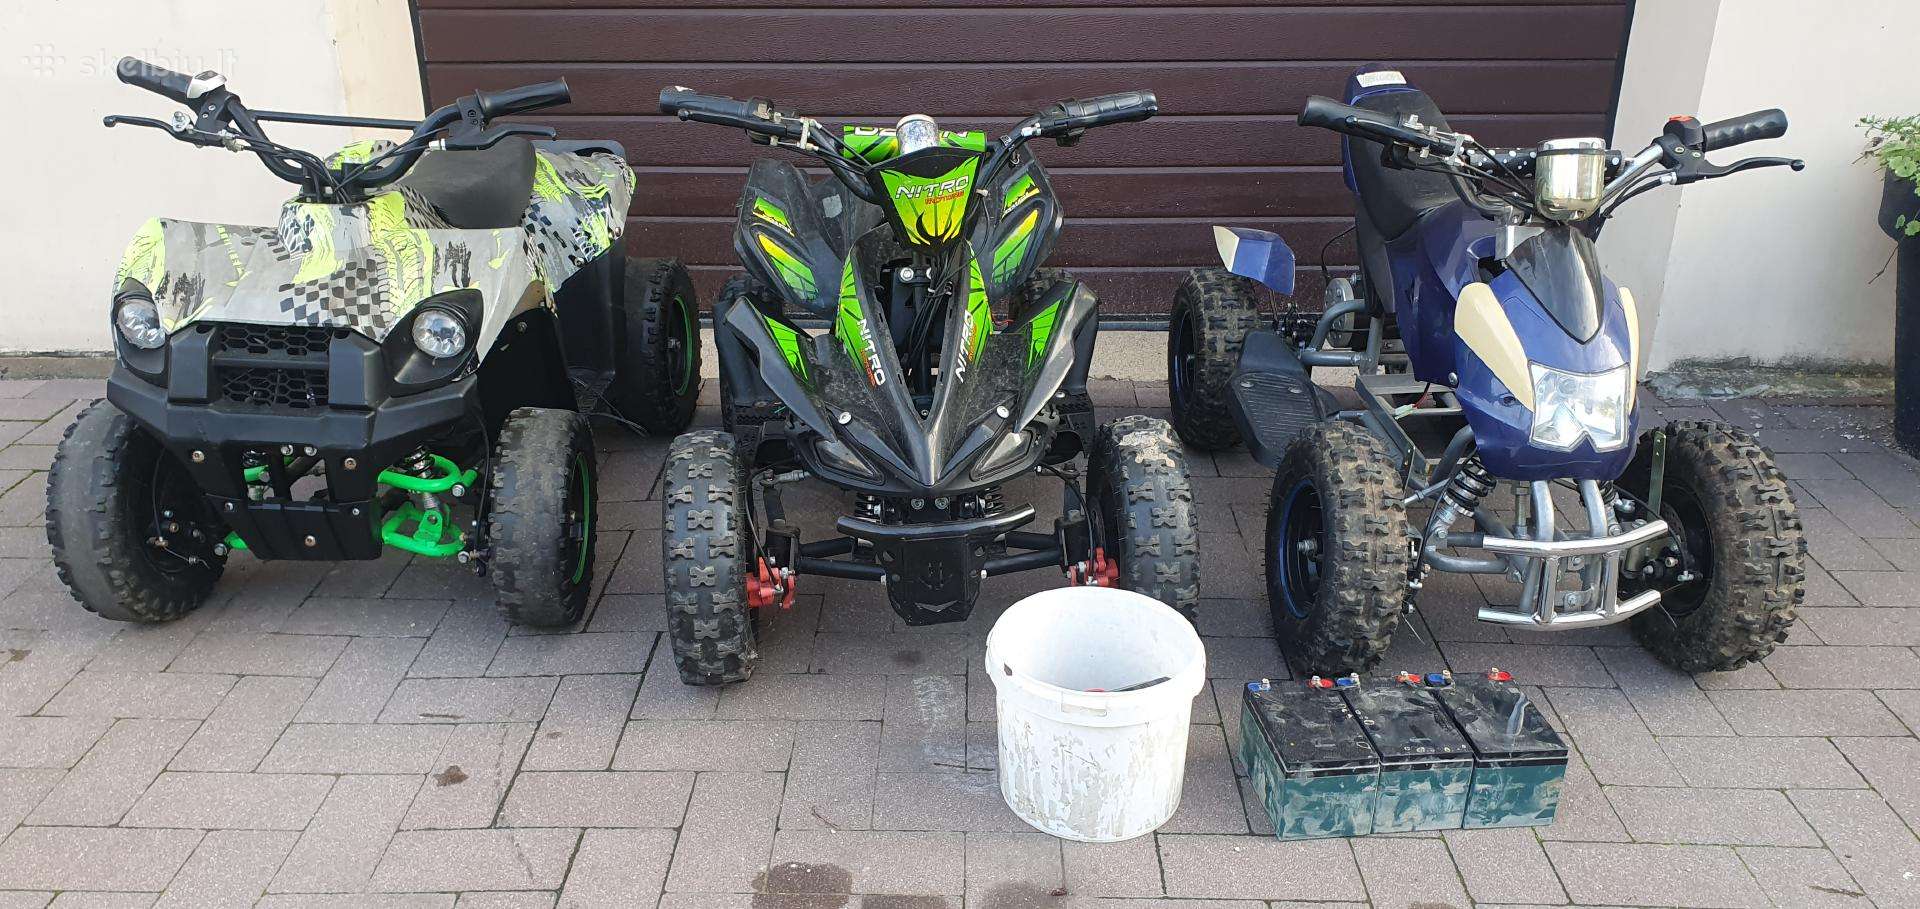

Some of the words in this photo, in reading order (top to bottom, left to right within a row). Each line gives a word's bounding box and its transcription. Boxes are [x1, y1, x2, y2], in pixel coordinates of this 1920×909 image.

[895, 175, 969, 199] NITRO
[857, 318, 886, 386] NITRO
[955, 310, 974, 383] NITRO
